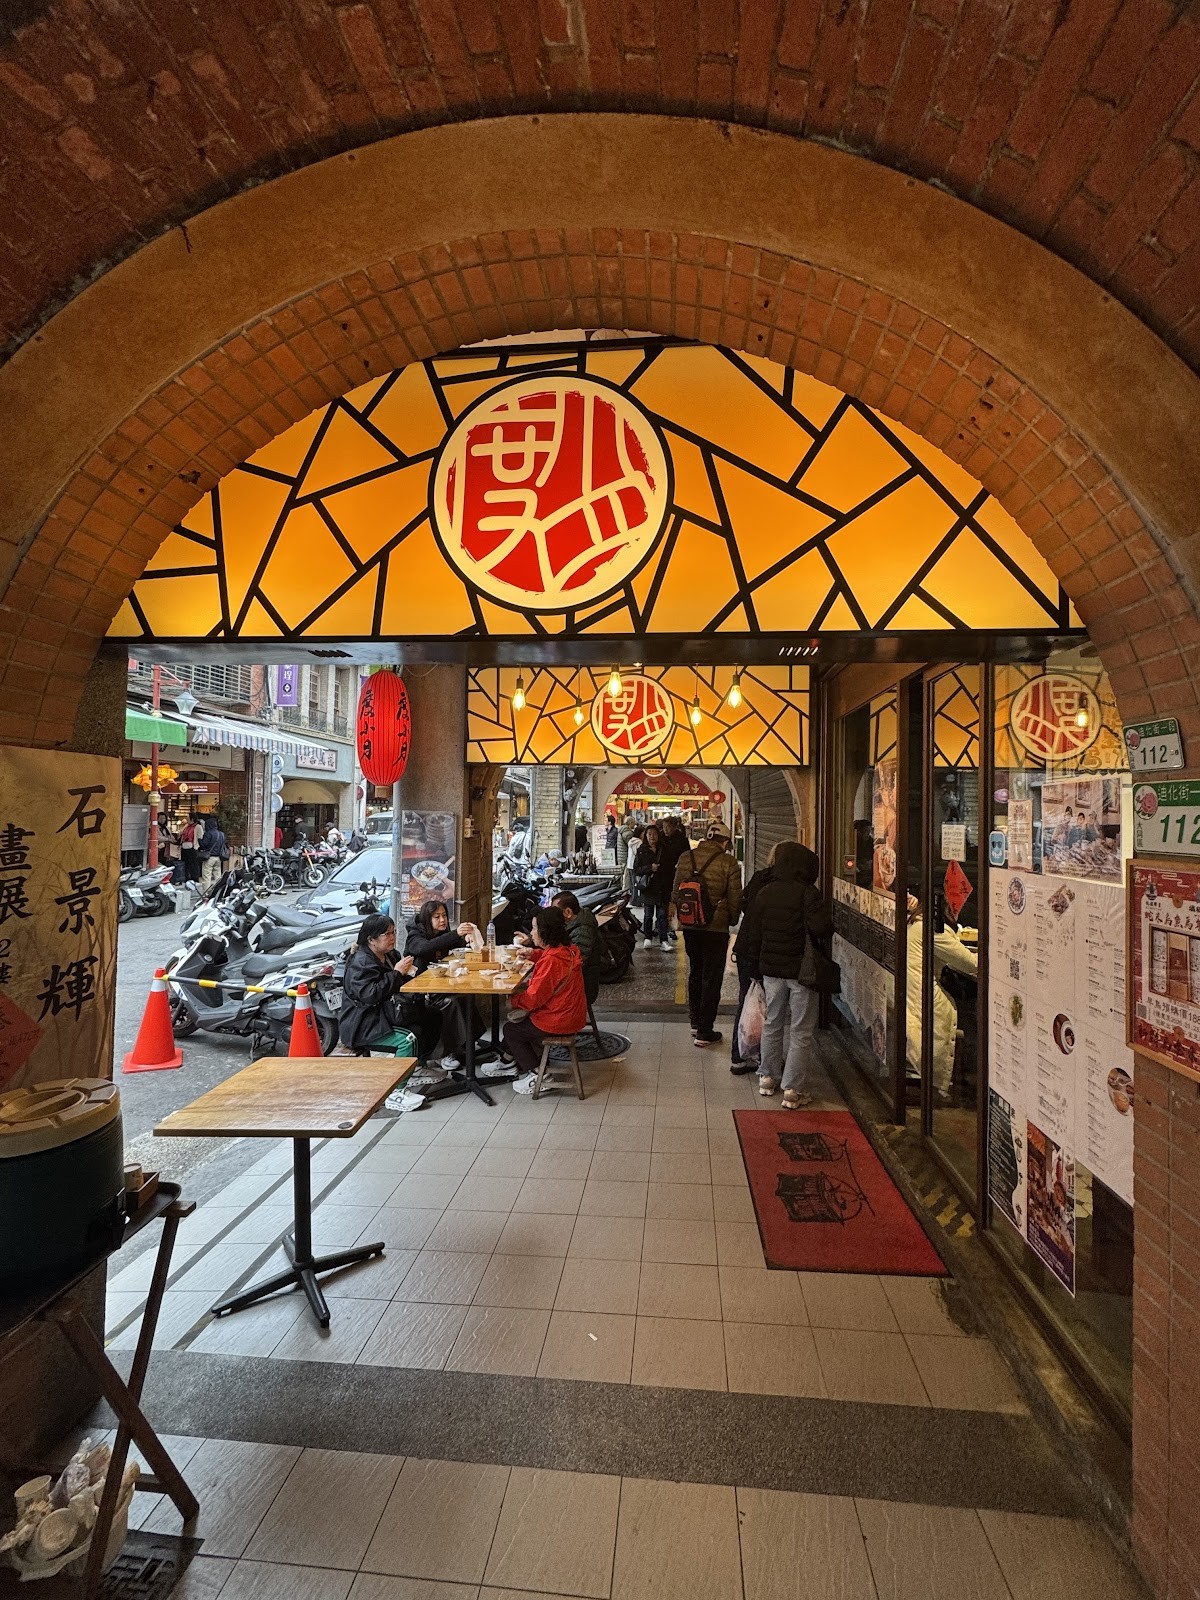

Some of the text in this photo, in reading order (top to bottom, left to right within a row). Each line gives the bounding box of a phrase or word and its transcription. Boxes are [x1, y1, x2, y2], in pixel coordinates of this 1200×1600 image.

[1160, 814, 1200, 845] 112
[36, 784, 107, 1023] 石景輝
